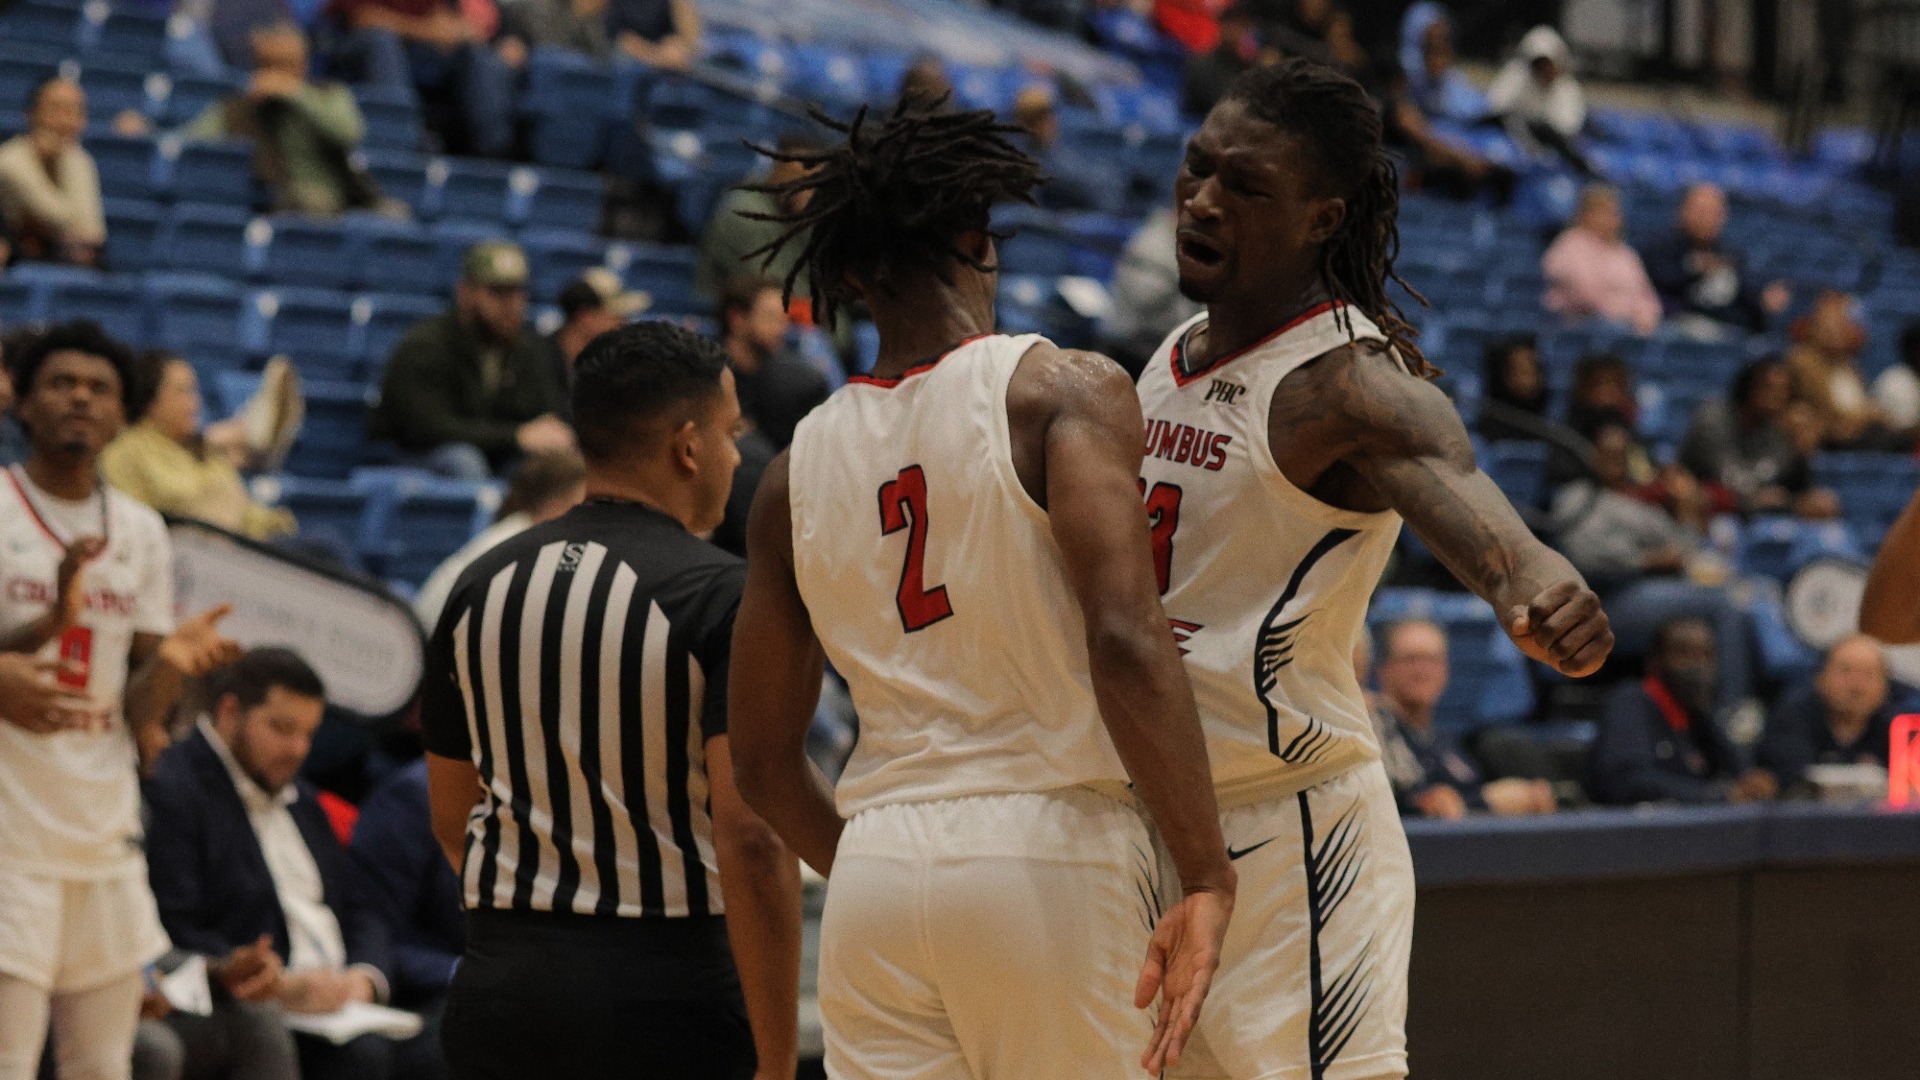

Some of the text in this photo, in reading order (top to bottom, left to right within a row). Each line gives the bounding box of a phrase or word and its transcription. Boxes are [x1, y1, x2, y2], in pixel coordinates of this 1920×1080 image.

[1205, 379, 1246, 404] PBC
[1144, 418, 1232, 472] UMBUS
[878, 464, 954, 634] 2
